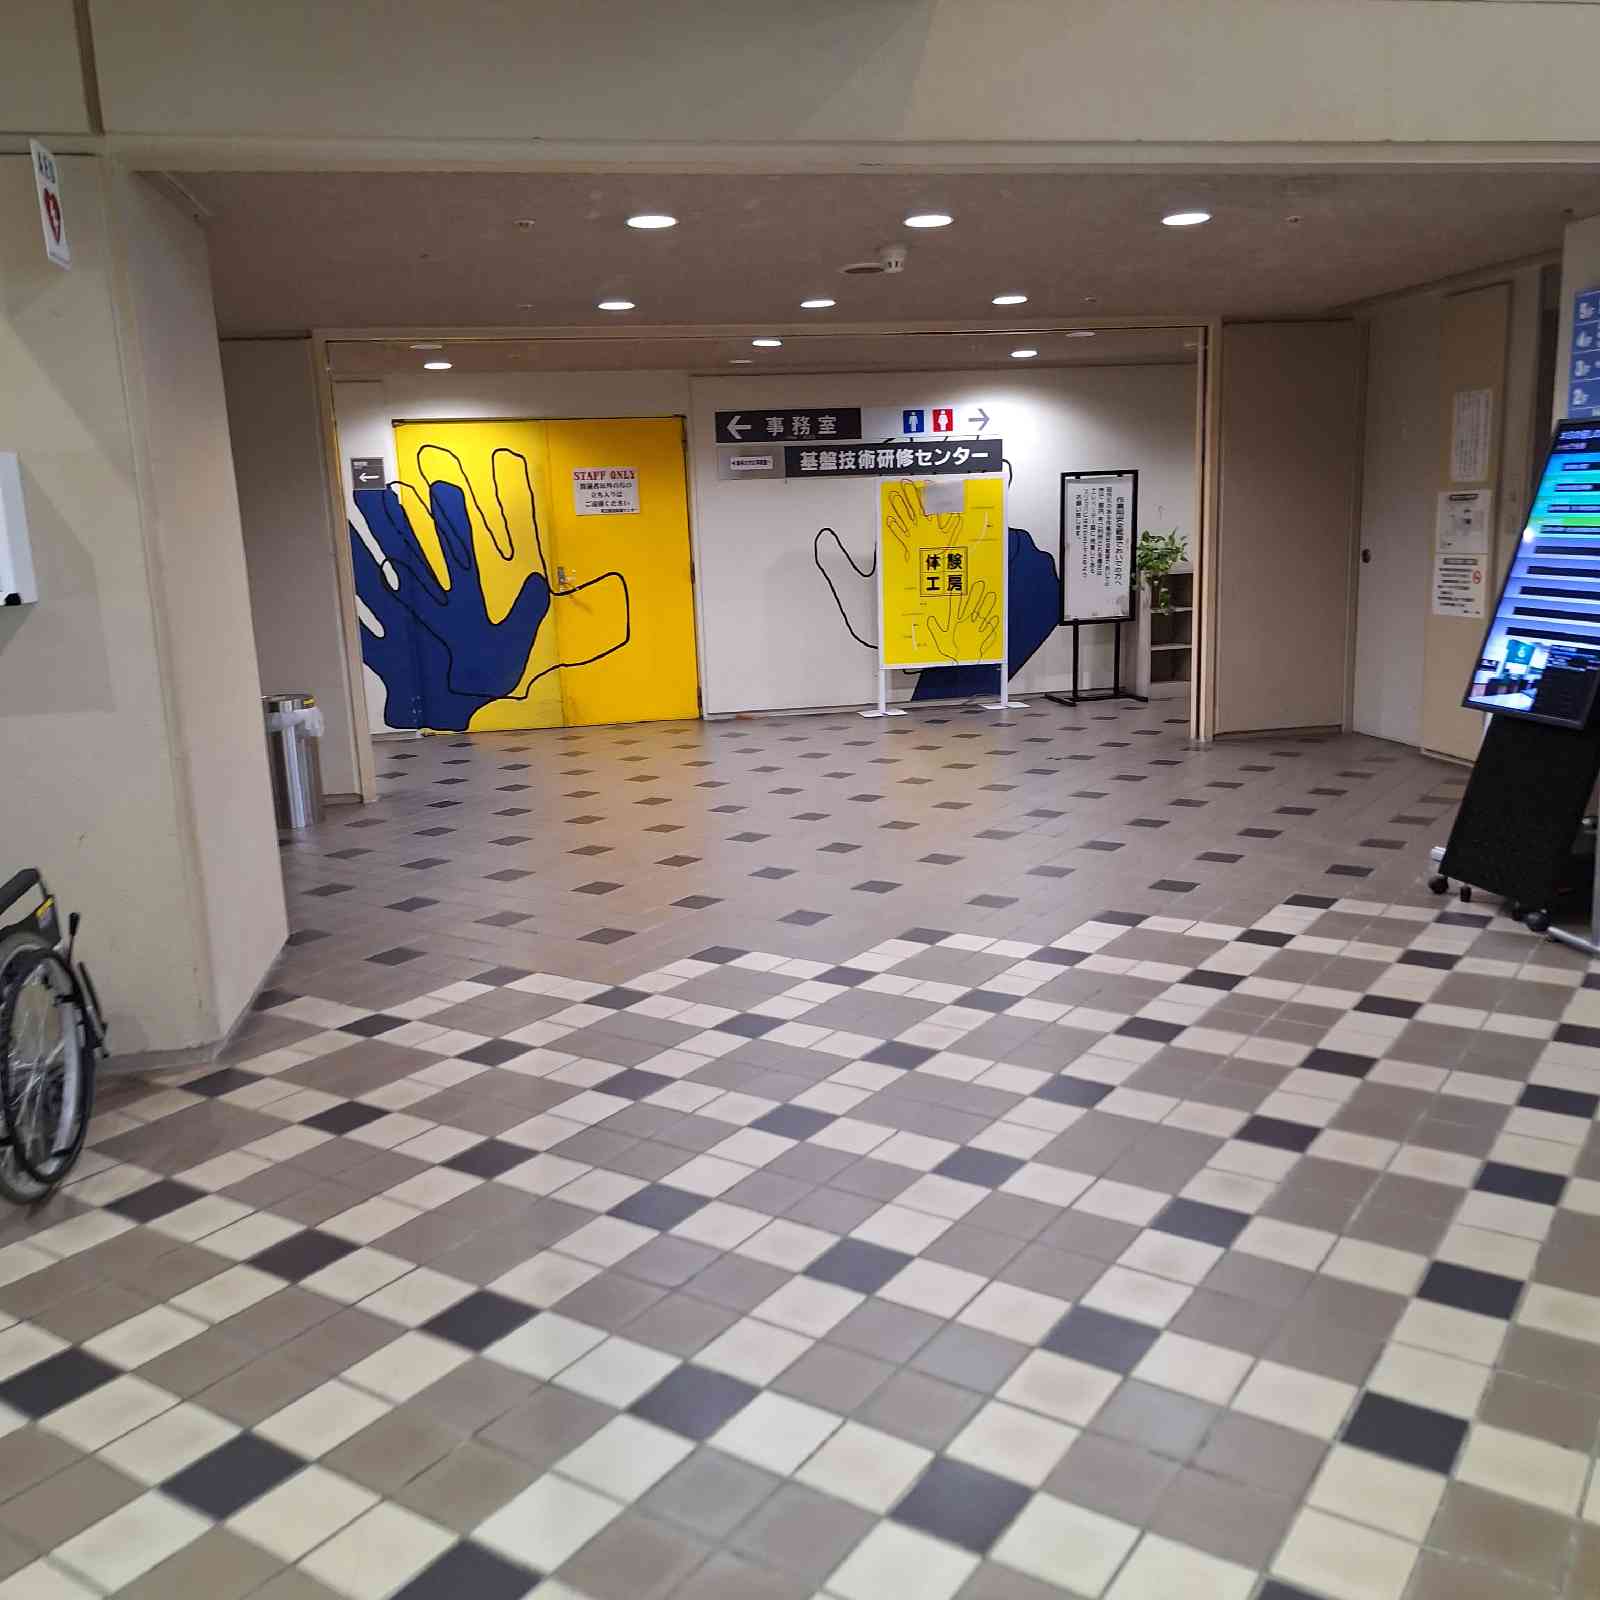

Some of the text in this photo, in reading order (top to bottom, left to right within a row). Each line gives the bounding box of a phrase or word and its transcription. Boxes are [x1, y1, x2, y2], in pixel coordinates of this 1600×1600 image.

[765, 415, 838, 438] 事務室
[799, 446, 989, 472] 基盤技術研修センター
[573, 470, 636, 481] STAFF ONLY
[926, 553, 964, 571] 体験
[926, 575, 964, 592] 工房
